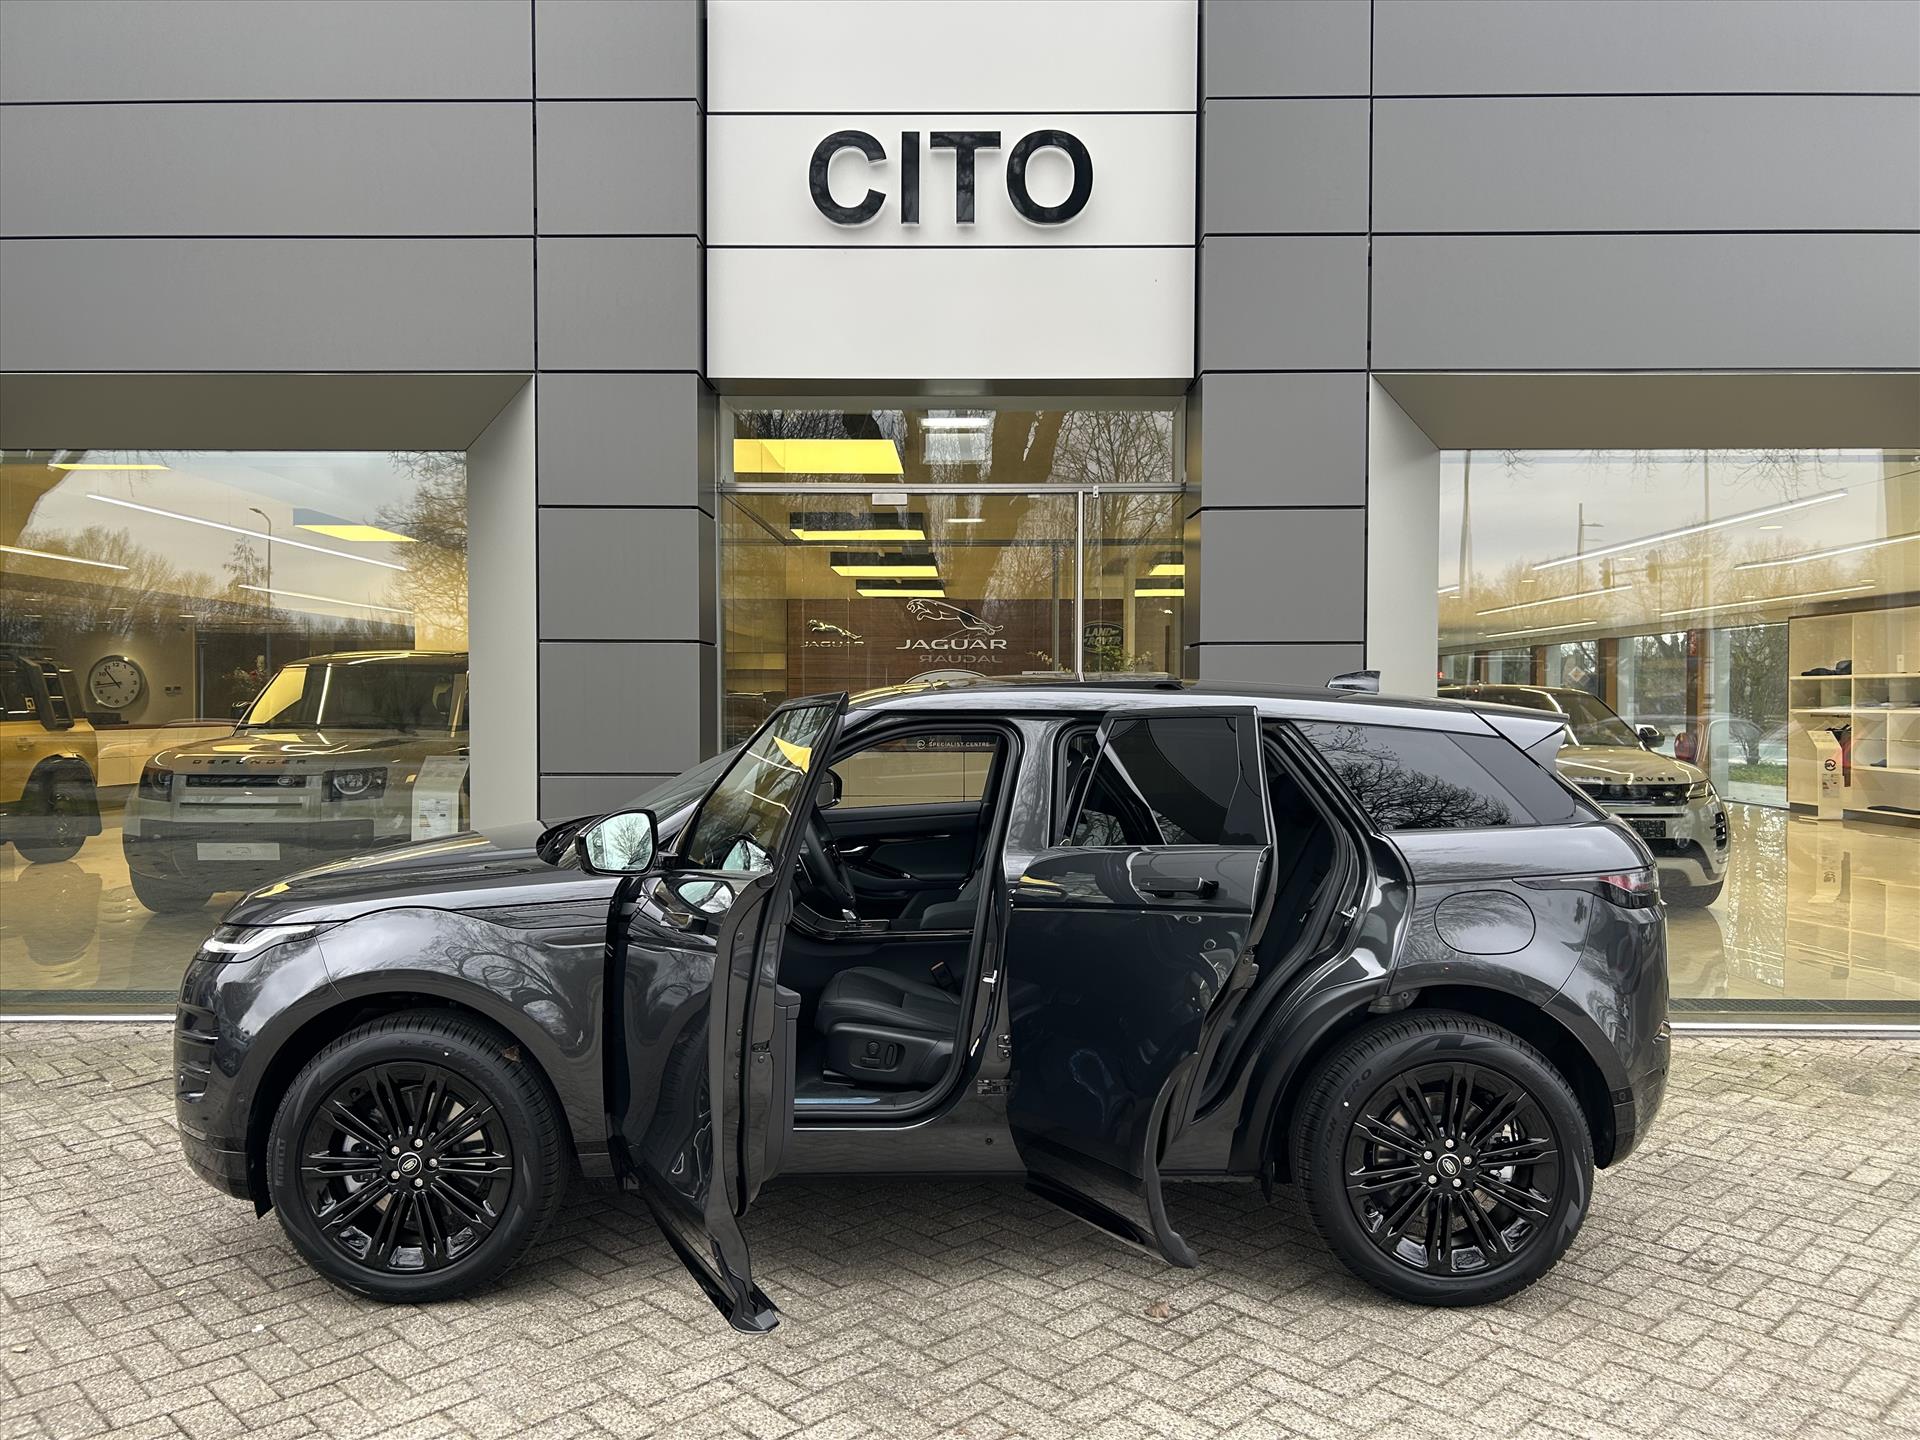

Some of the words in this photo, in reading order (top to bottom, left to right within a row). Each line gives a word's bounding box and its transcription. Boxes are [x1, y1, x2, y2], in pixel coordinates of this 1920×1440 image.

[808, 129, 1094, 225] CITO
[1085, 627, 1112, 637] LAND
[895, 639, 1008, 650] JAGUAR
